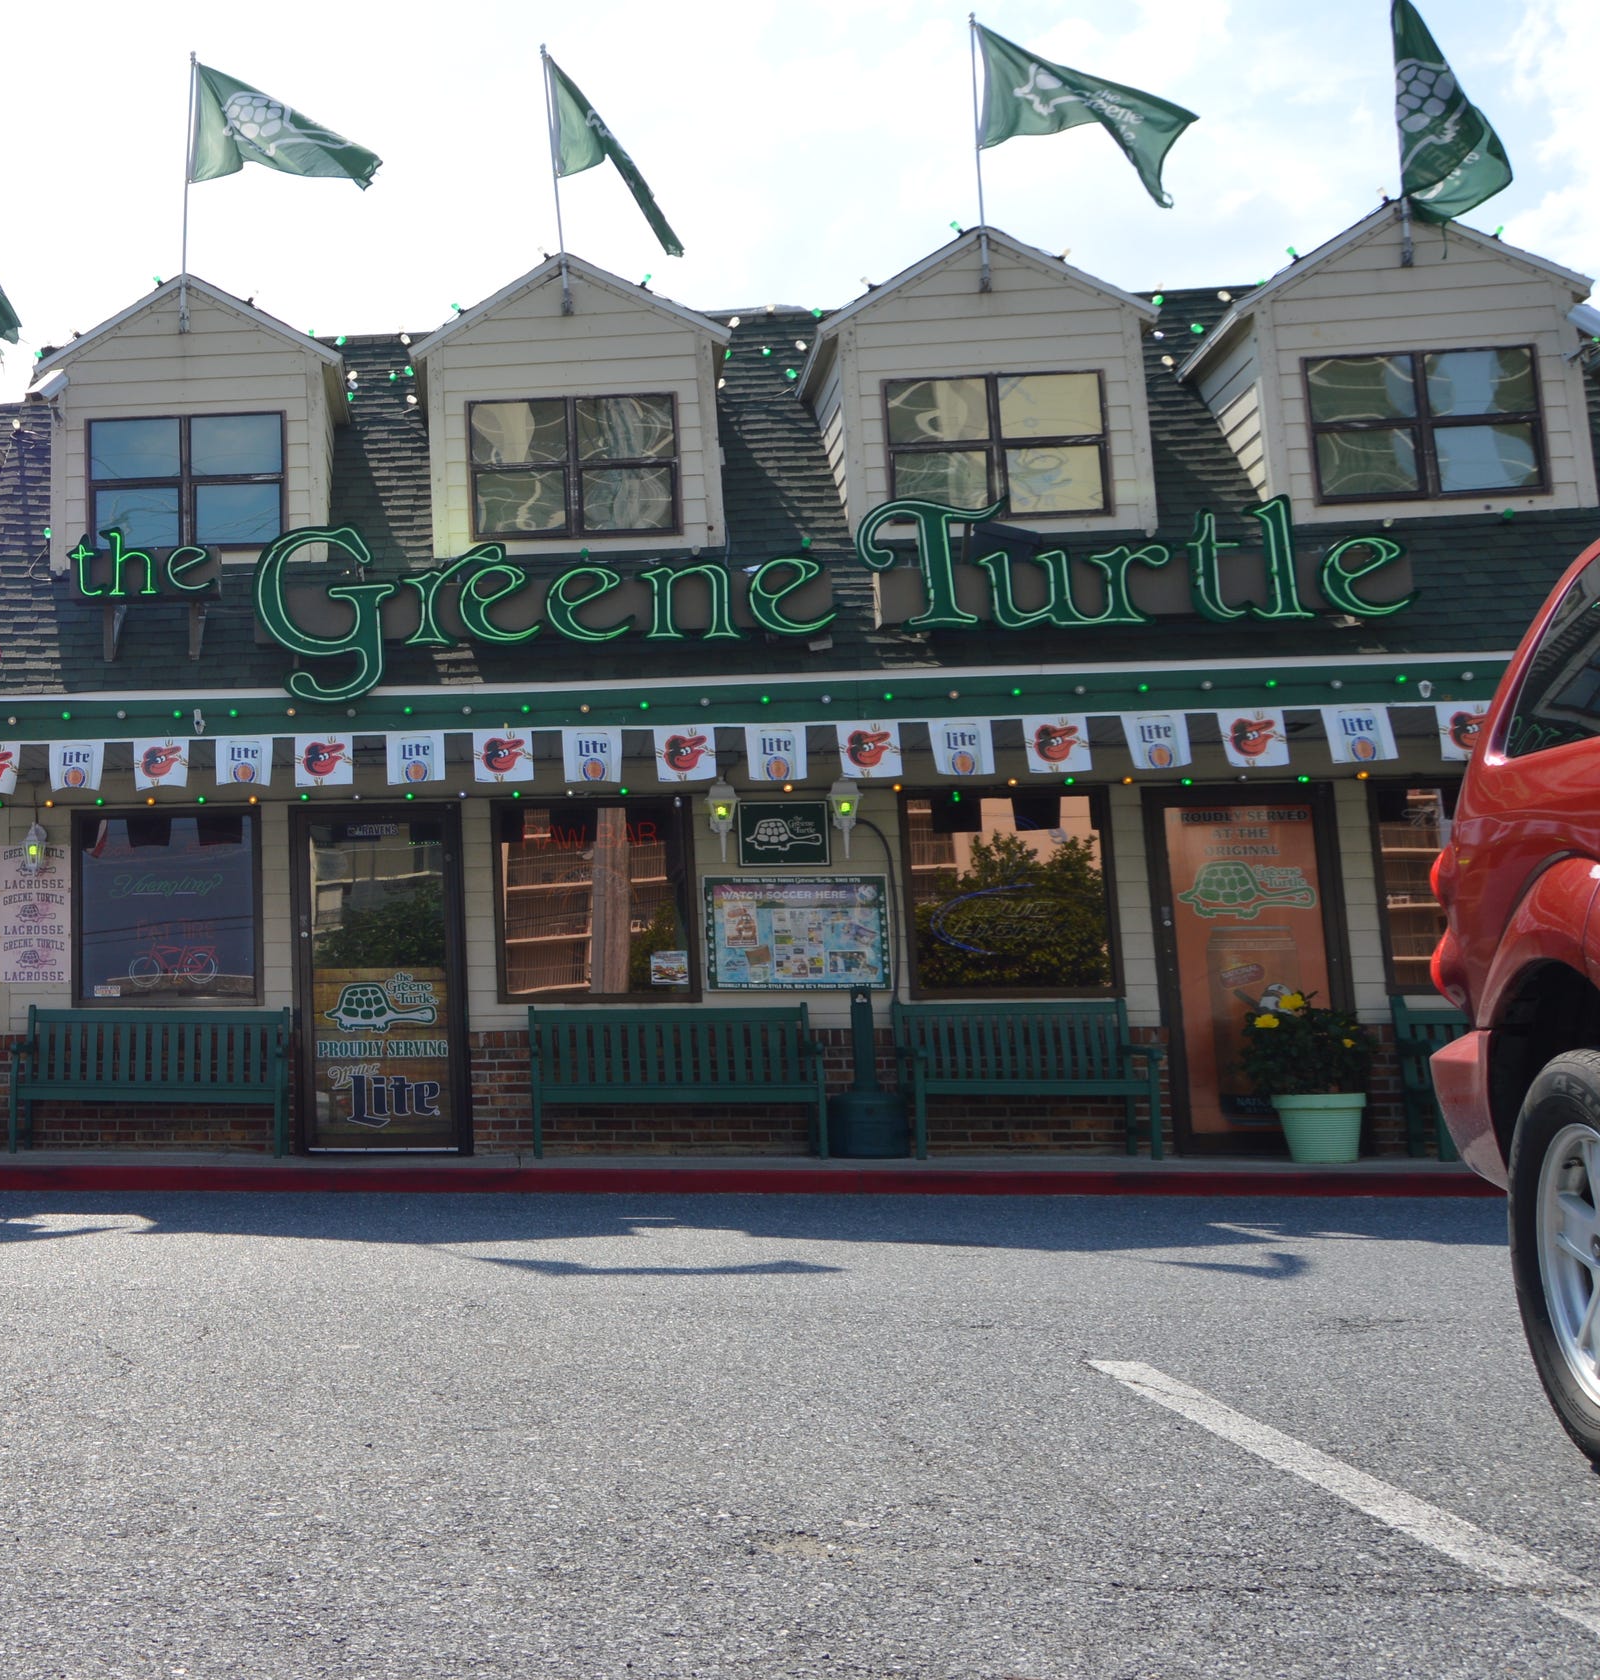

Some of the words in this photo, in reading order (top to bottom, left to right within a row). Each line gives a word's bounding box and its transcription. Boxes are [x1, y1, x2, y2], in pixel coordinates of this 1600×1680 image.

[69, 526, 218, 597] the
[254, 525, 840, 701] Greene
[855, 495, 1420, 630] Turtle
[1140, 724, 1172, 743] Lite
[1340, 718, 1373, 735] Lite
[762, 737, 791, 753] Lite
[946, 732, 976, 748] Lite
[230, 747, 258, 761] Lite
[402, 744, 430, 759] Lite
[578, 740, 607, 756] Lite
[62, 751, 90, 766] Lite
[1247, 810, 1308, 821] SERVED
[361, 824, 398, 836] RAVENS
[521, 823, 586, 849] RAW
[599, 822, 658, 848] BAR
[1237, 827, 1269, 839] THE
[1204, 844, 1280, 856] ORIGINAL
[1254, 865, 1302, 880] Greene
[4, 879, 65, 890] LACROSSE
[1268, 877, 1307, 888] Turtle
[3, 892, 33, 906] GREENE
[36, 892, 65, 905] TURTLE
[722, 889, 762, 900] WATCH
[766, 889, 811, 899] SOCCER
[815, 888, 848, 899] HERE
[4, 925, 64, 936] LACROSSE
[3, 938, 34, 952] GREENE
[36, 938, 65, 951] TURTLE
[4, 971, 65, 982] LACROSSE
[396, 972, 412, 982] the
[385, 981, 432, 995] Greene
[317, 1040, 383, 1058] PROUDLY
[387, 1040, 448, 1058] SERVING
[328, 1062, 380, 1090] Miller
[347, 1074, 441, 1128] Lite
